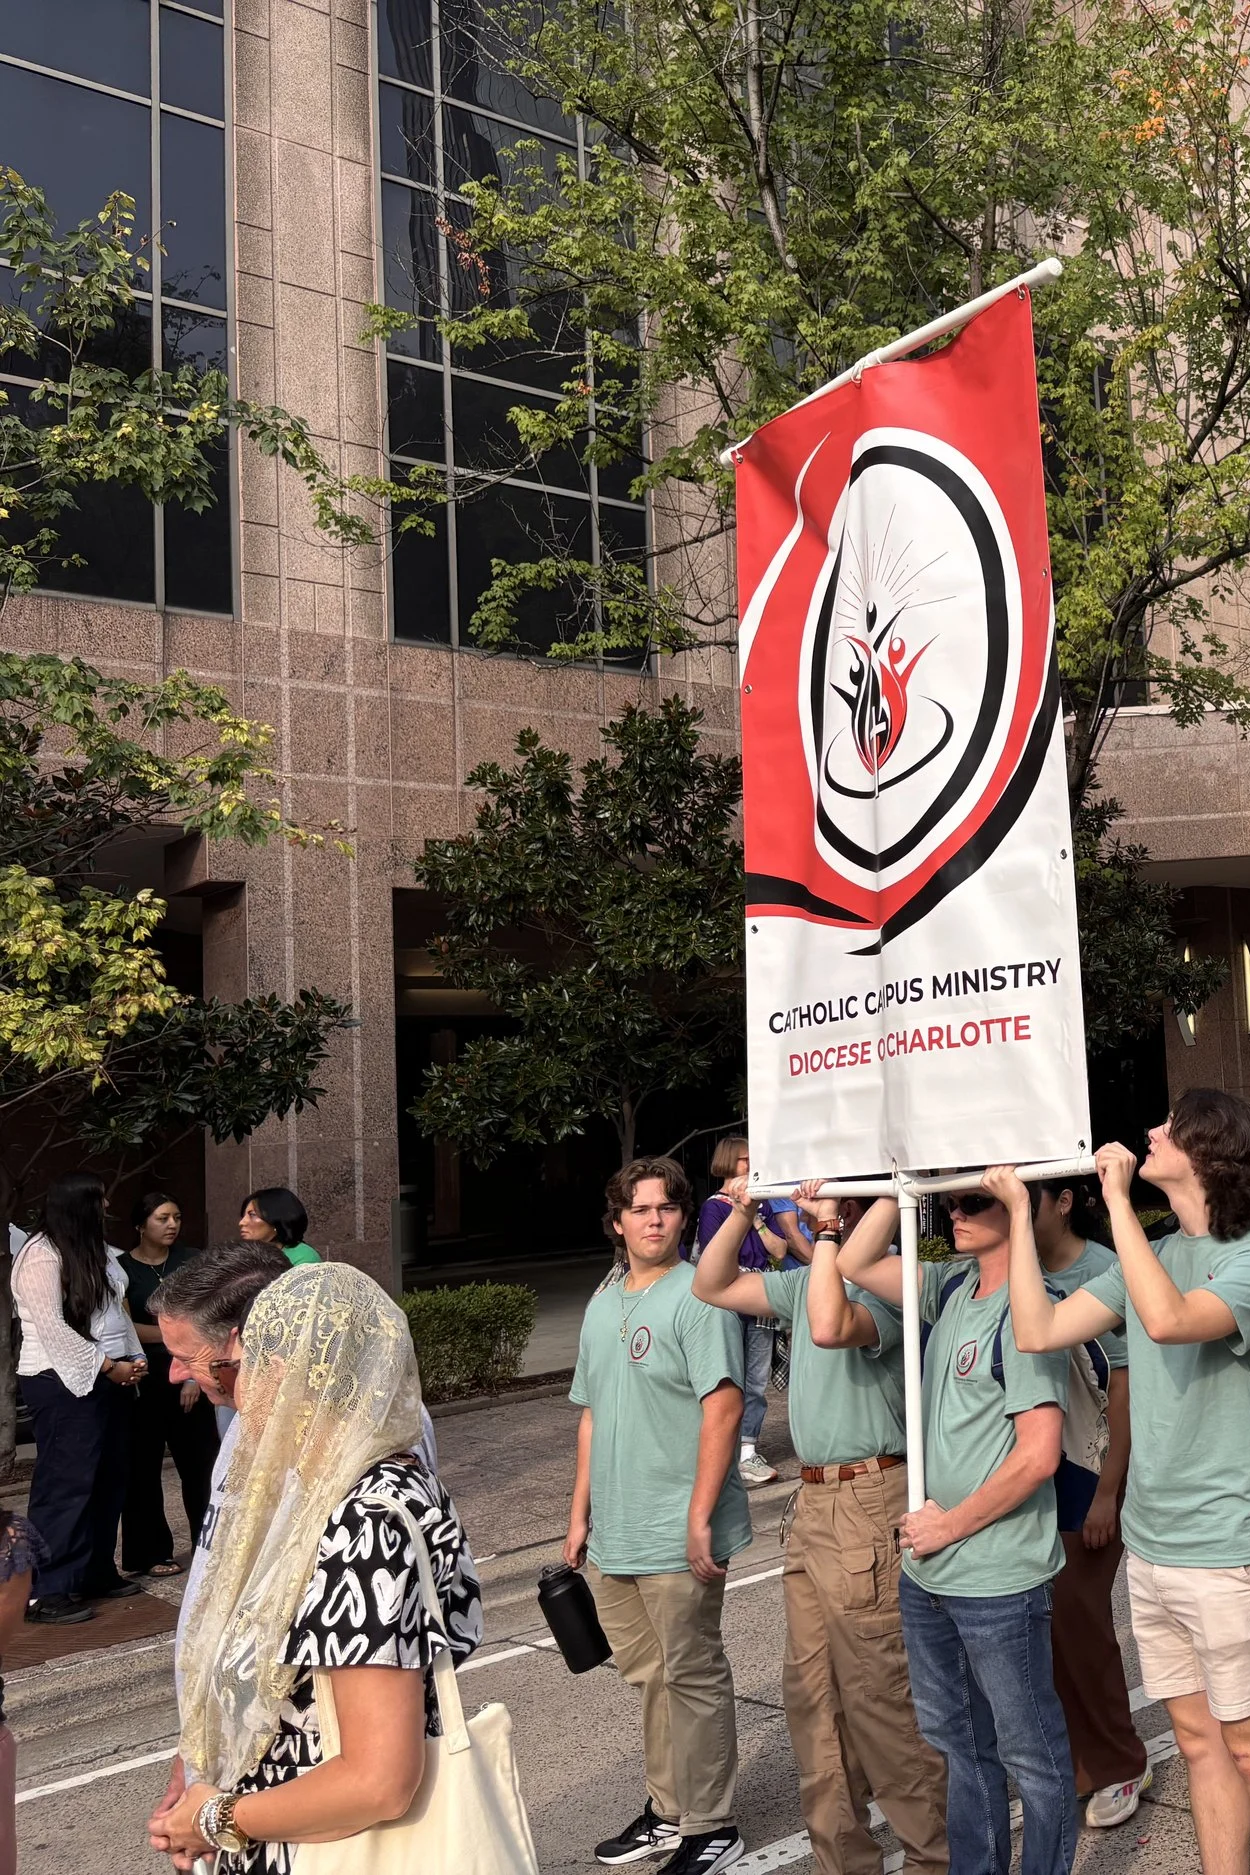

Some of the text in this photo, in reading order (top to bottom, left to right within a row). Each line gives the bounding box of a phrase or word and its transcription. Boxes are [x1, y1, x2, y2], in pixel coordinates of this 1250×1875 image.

[768, 957, 1062, 1034] CATHOLIC CAPUS MINISTRY
[789, 1040, 872, 1077] DIOCESE
[886, 1015, 1032, 1058] CHARLOTTE
